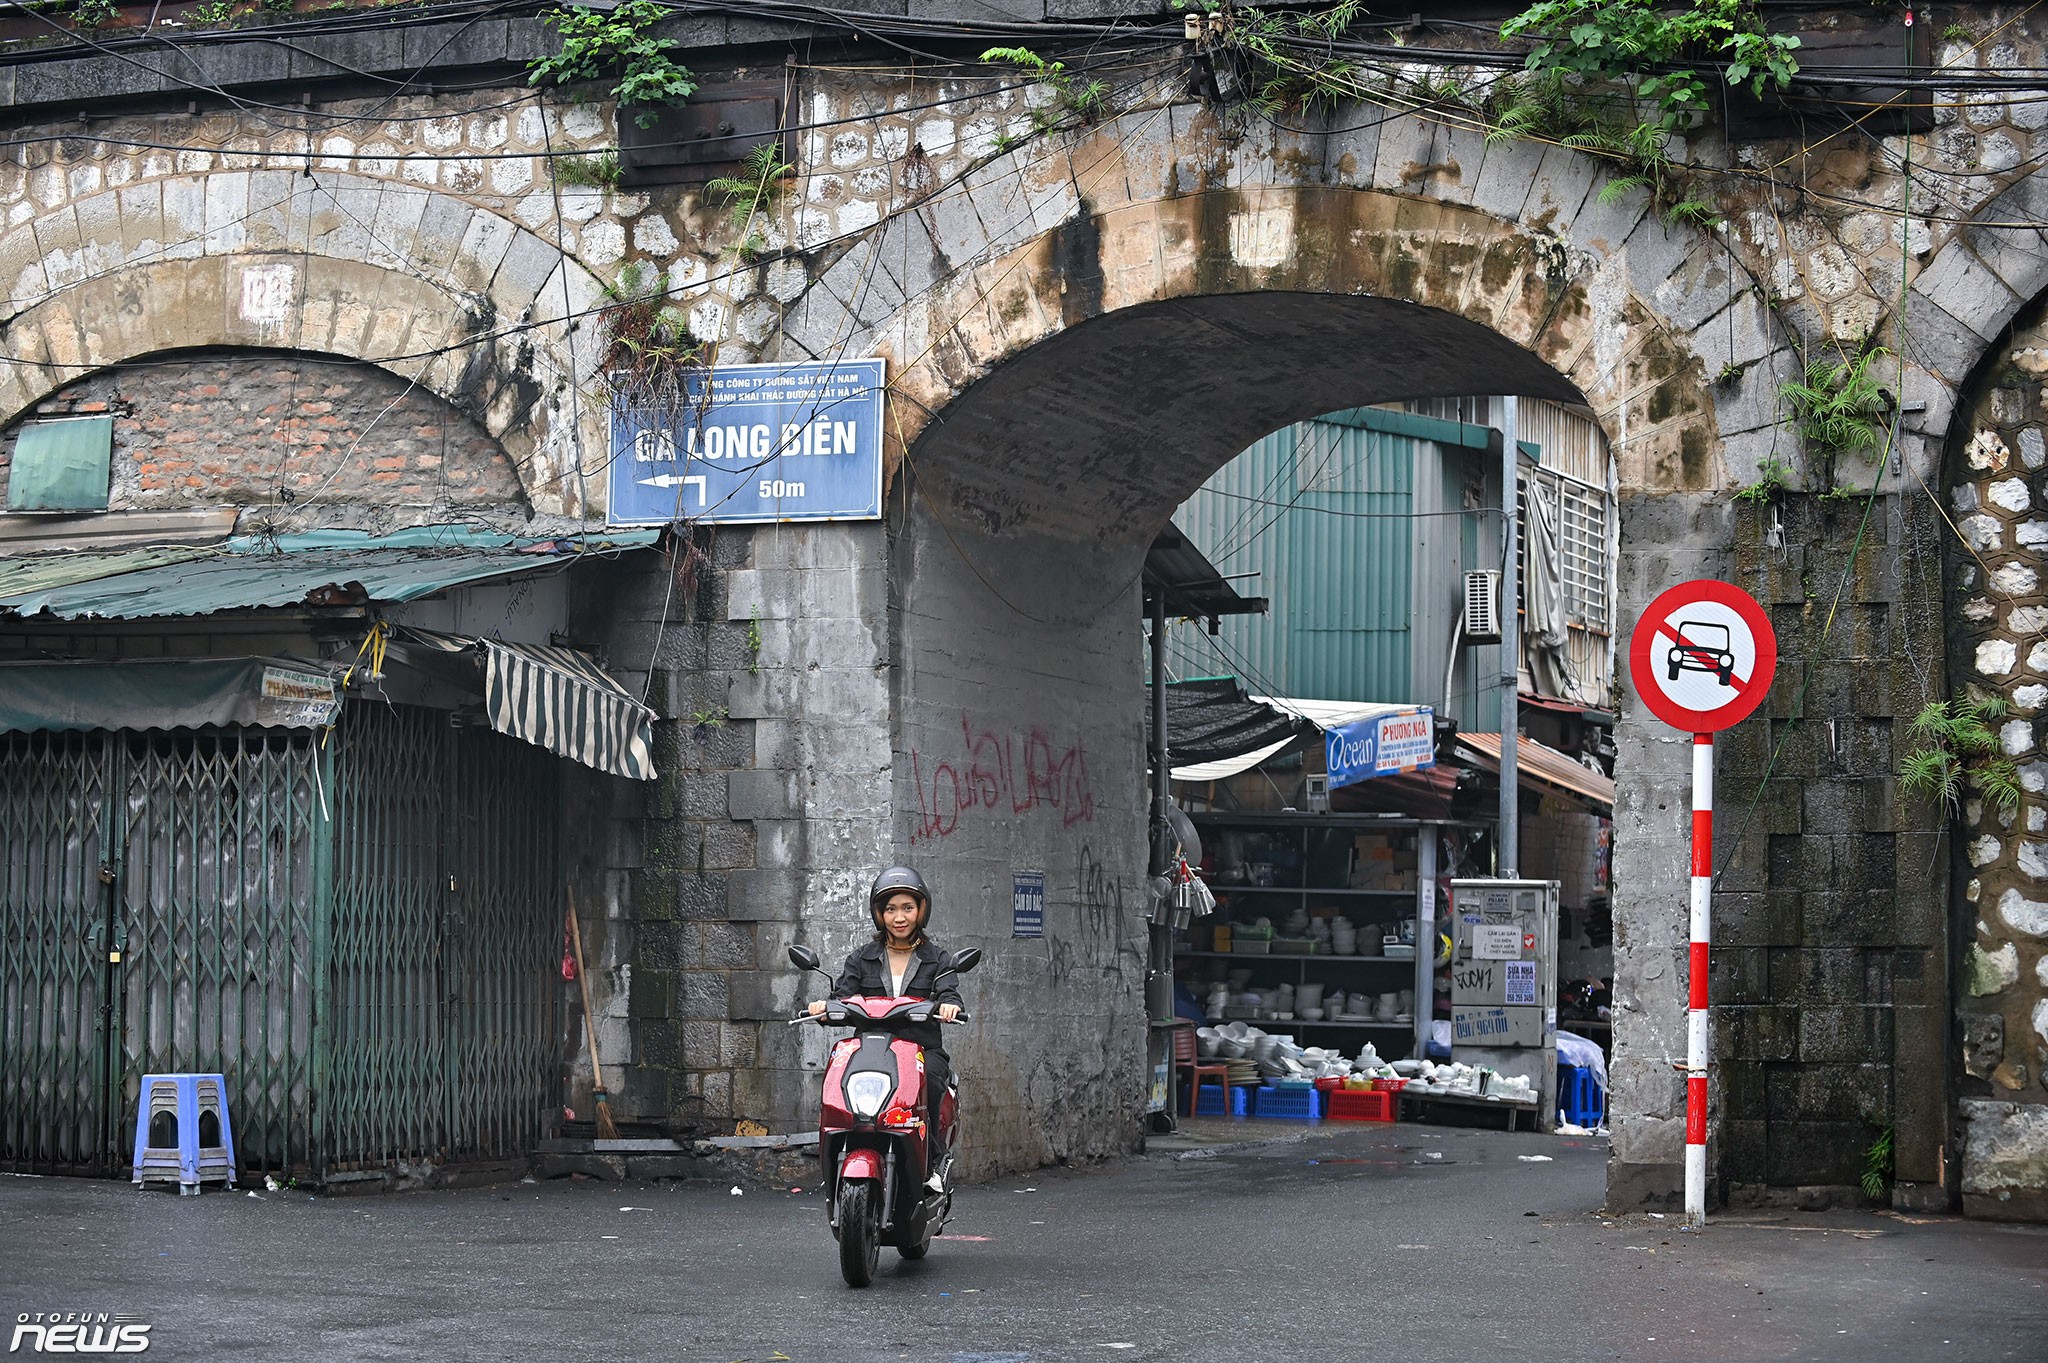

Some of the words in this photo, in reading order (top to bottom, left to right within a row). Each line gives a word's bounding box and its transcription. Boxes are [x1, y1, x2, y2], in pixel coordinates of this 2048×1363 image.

[701, 379, 724, 390] TNG
[726, 377, 750, 388] CÔNG
[753, 378, 764, 387] TY
[797, 373, 814, 385] SẮT
[837, 374, 858, 384] NAM
[761, 389, 784, 400] THÁC
[838, 386, 850, 397] HÀ
[634, 428, 677, 463] GA
[686, 422, 771, 461] LONG
[780, 414, 857, 456] BIÊN
[758, 480, 805, 499] 50m
[1412, 720, 1427, 737] NGA
[1329, 733, 1373, 771] Ocean
